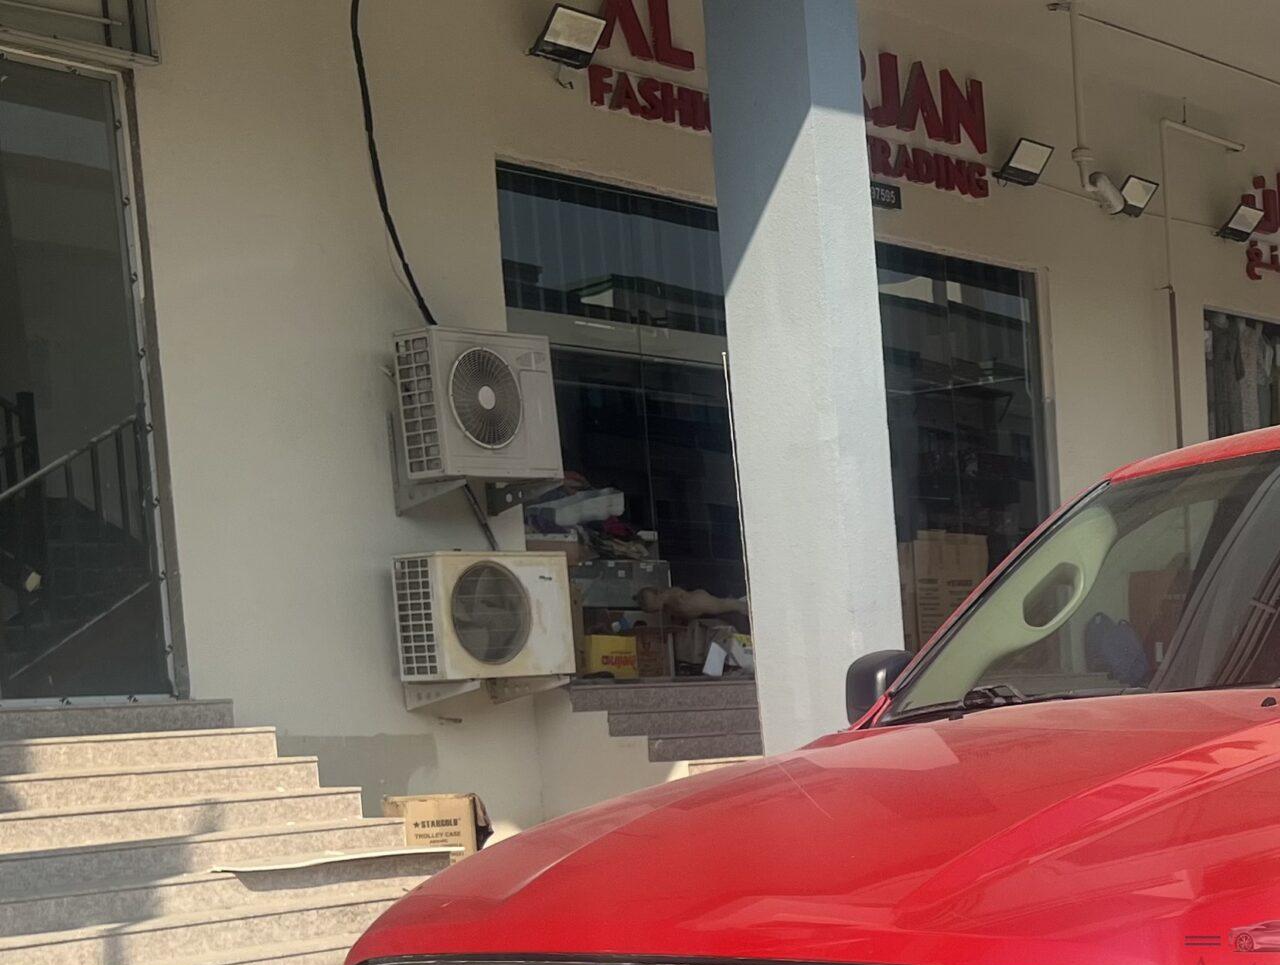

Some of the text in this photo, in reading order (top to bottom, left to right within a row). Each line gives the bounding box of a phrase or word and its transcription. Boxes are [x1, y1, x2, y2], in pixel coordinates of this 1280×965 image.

[588, 64, 989, 199] FASHI RADING
[597, 0, 988, 154] AL JAN
